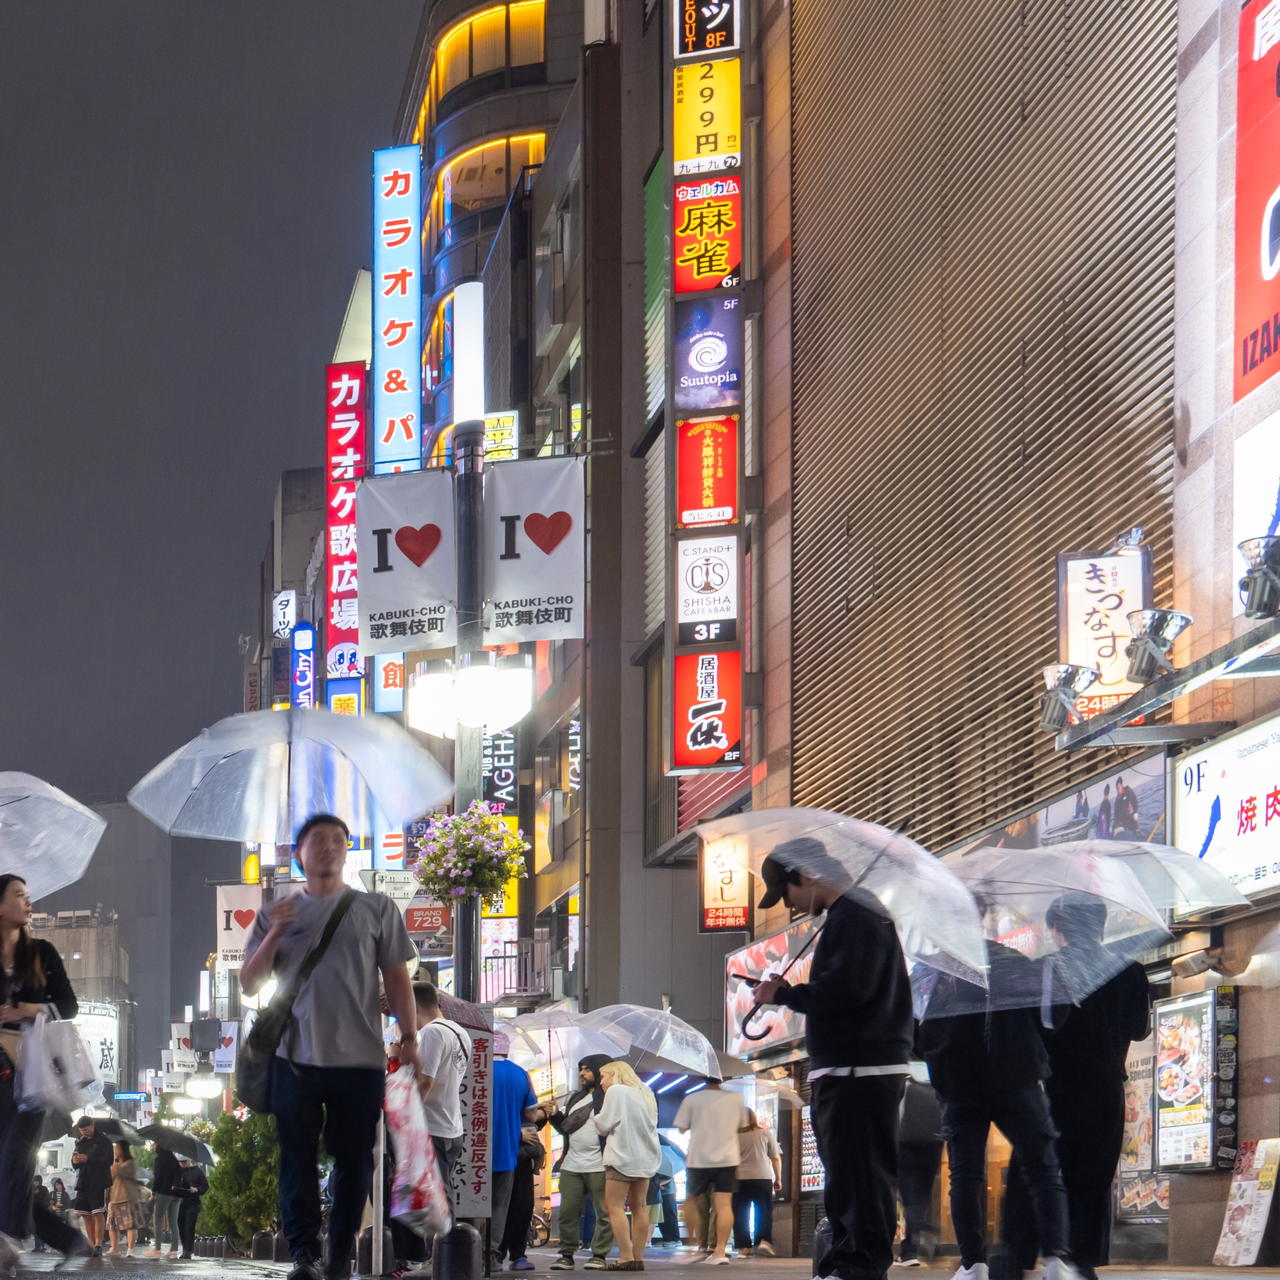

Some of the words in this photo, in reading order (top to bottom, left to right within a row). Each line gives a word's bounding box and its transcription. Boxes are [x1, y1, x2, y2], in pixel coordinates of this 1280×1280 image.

[706, 32, 726, 48] 8F
[696, 63, 719, 155] 299円
[679, 159, 720, 174] 九十九
[676, 179, 739, 201] ウェルカム
[678, 202, 736, 279] 麻雀
[721, 274, 740, 288] 6F
[723, 299, 739, 310] 5F
[680, 371, 738, 388] Suutopia
[330, 373, 359, 631] カラオケ歌広場
[499, 515, 521, 562] I
[372, 527, 393, 573] I
[493, 594, 574, 612] KABUKI-CHO
[683, 597, 732, 608] SHISHA
[369, 605, 447, 623] KABUKI-CHO
[495, 605, 573, 628] 歌舞伎町
[370, 617, 446, 641] 歌舞伎町
[694, 624, 721, 641] 3F
[1083, 563, 1130, 687] きづなすし
[699, 657, 716, 699] 居酒屋
[724, 751, 740, 761] 2F
[483, 757, 493, 777] PUB
[1184, 760, 1208, 798] 9F
[490, 802, 506, 814] 2F
[223, 909, 234, 931] I
[412, 916, 443, 927] 729
[708, 907, 744, 918] 24時間
[705, 916, 746, 929] 年中無休
[222, 954, 246, 962] 歌舞伎
[471, 1037, 489, 1202] 客引きは条例違反です。
